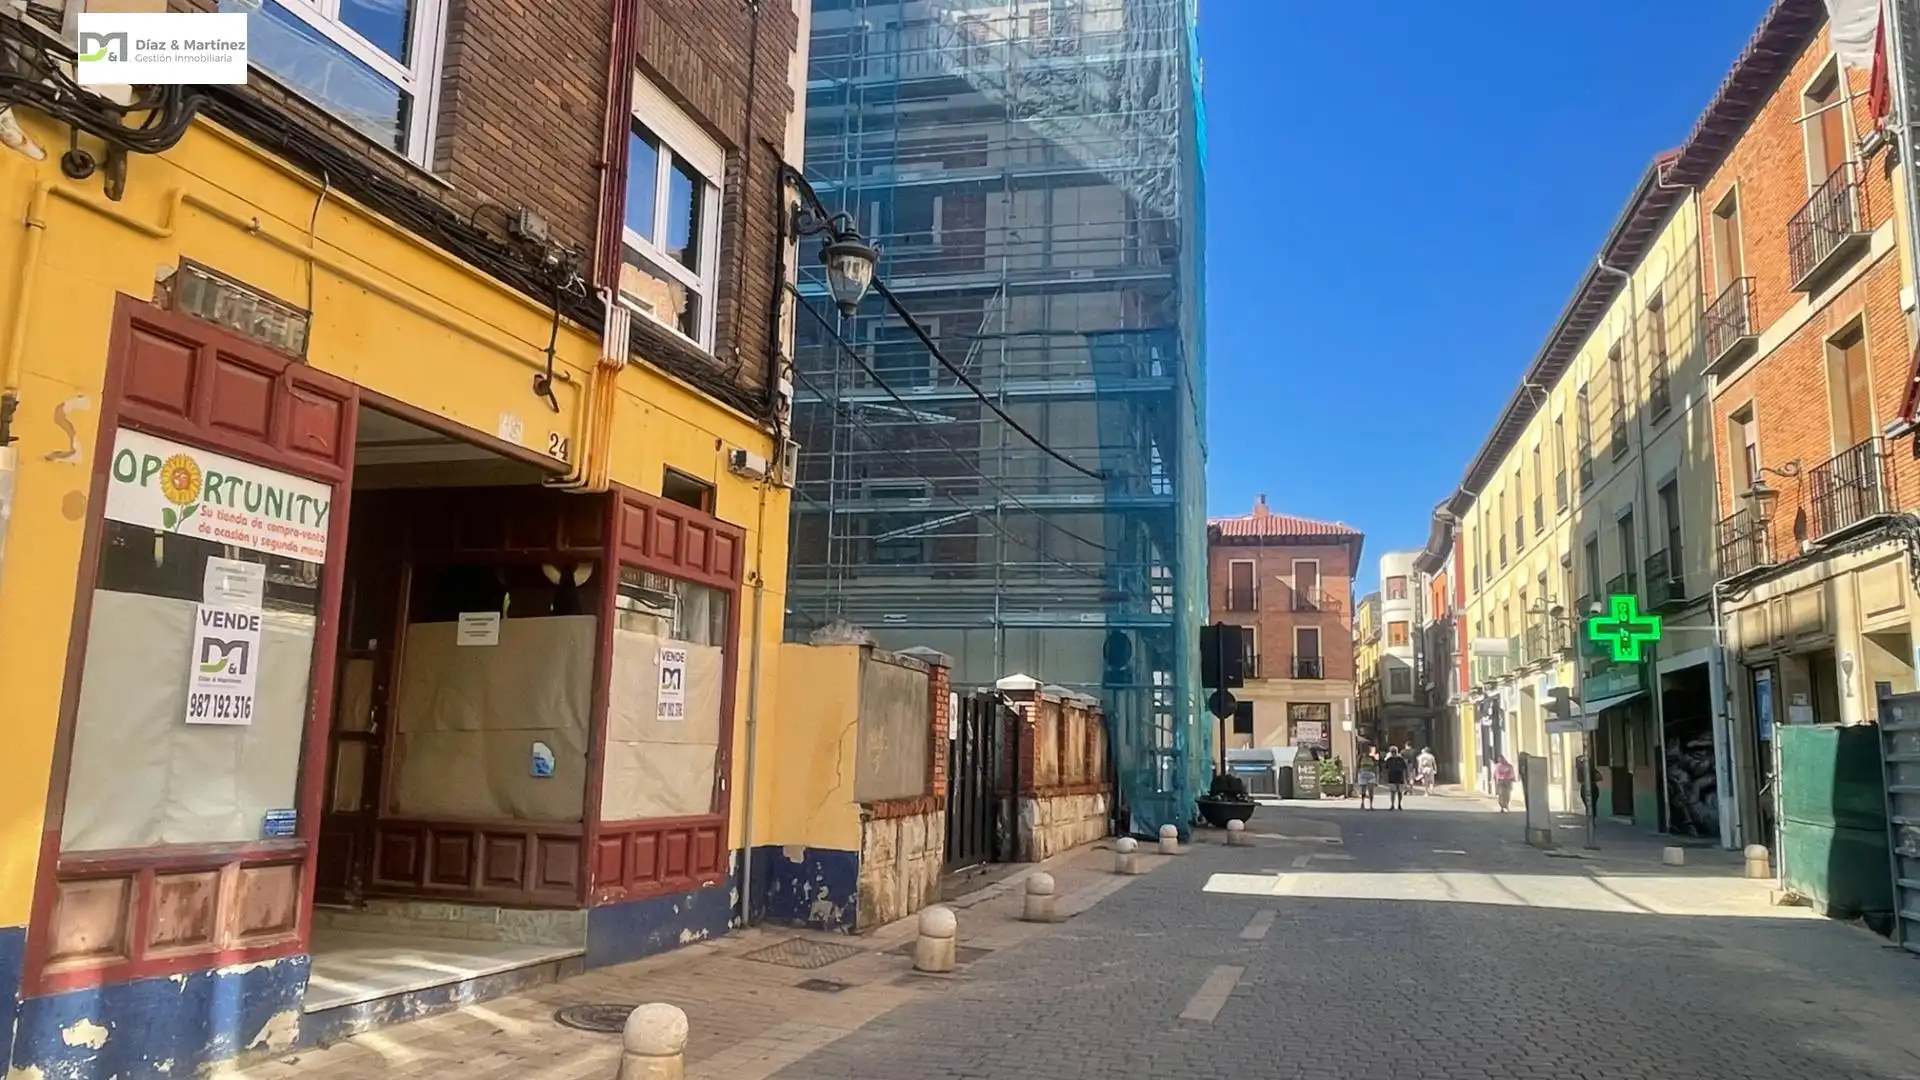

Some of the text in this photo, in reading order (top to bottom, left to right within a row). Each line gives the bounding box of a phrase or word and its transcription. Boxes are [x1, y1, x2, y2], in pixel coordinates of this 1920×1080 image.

[549, 433, 568, 460] 24
[200, 504, 325, 543] Su tienda de compra-venta
[198, 522, 211, 534] de
[214, 527, 250, 542] ocasión
[253, 535, 259, 547] y
[260, 535, 298, 553] segunda
[201, 609, 260, 632] VENDE
[662, 651, 684, 662] VENDE
[190, 692, 252, 719] 987 192 316
